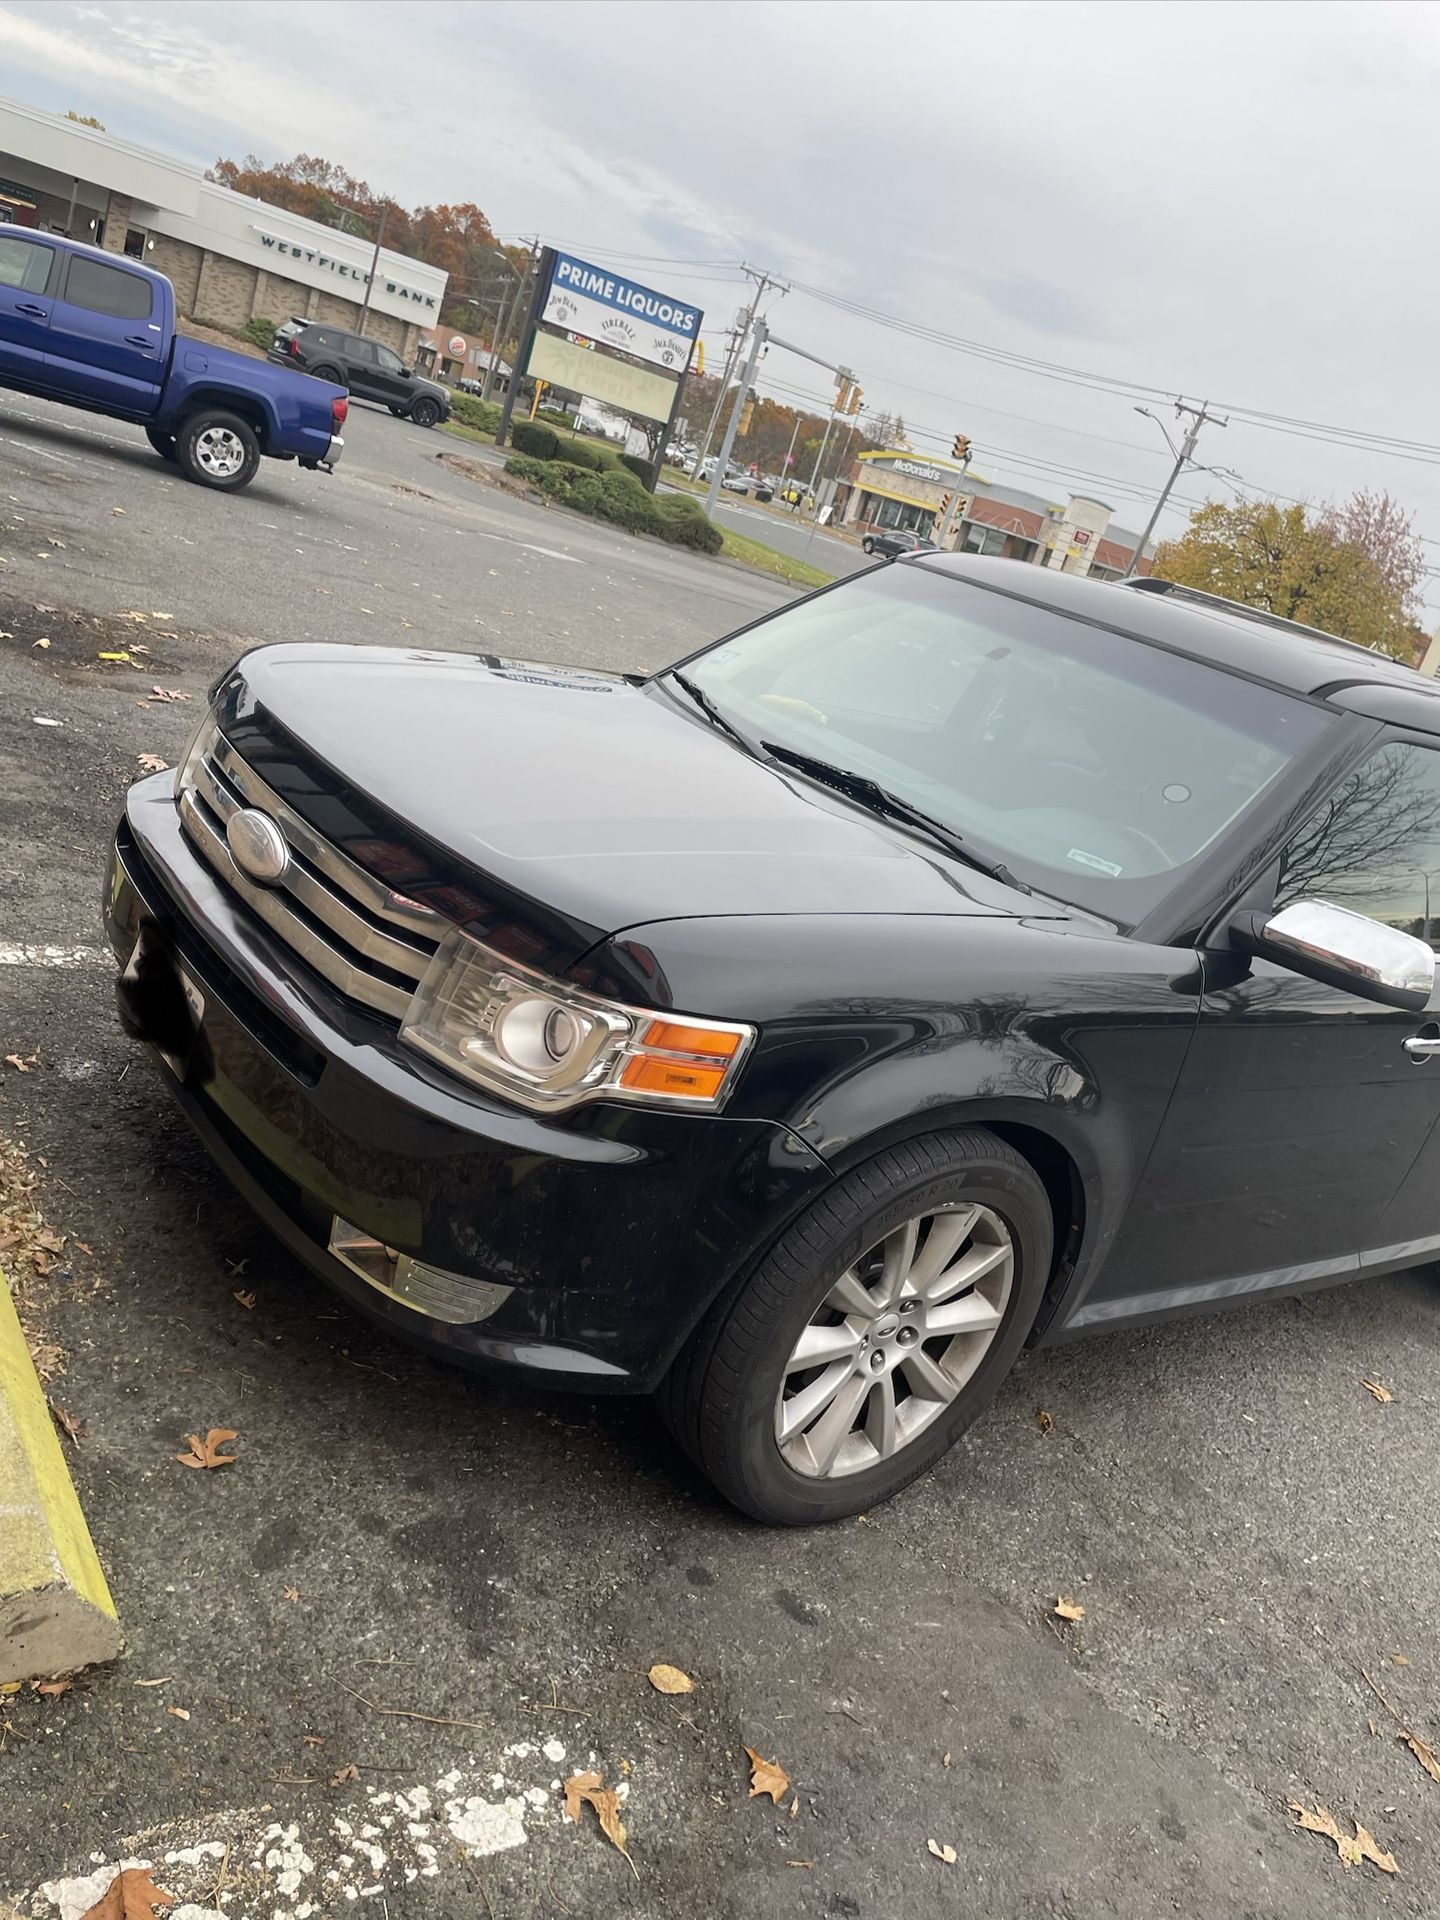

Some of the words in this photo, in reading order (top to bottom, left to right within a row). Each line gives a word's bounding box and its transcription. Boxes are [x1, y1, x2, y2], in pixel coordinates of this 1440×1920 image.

[261, 235, 372, 285] WESTFIELD
[386, 282, 436, 309] BANK
[557, 261, 615, 299] PRIME
[615, 285, 695, 332] LIQUORS
[601, 317, 636, 340] FIREBALL
[892, 458, 941, 481] McDonald's
